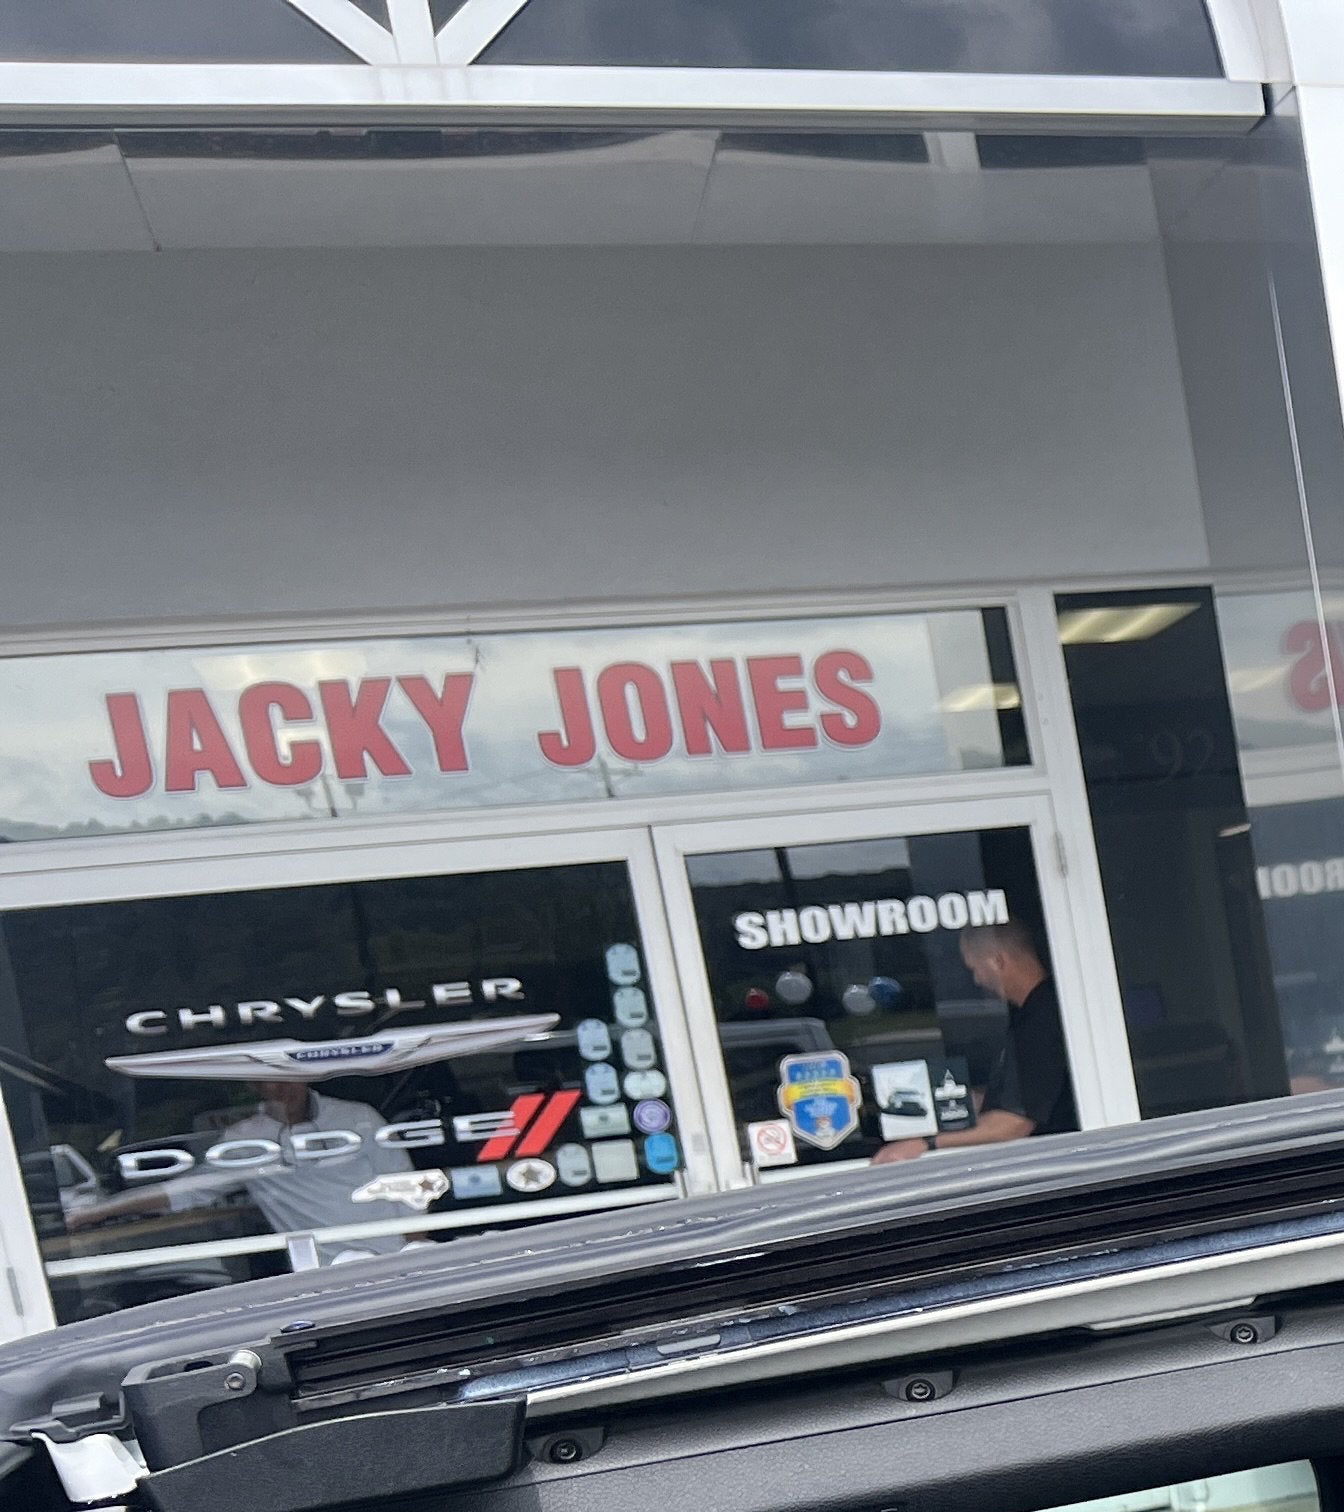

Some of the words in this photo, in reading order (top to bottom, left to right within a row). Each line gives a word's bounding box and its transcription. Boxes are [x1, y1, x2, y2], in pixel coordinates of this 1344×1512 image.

[88, 671, 476, 798] JACKY
[537, 648, 882, 767] JONES
[733, 889, 1011, 951] SHOWROOM
[125, 977, 526, 1036] CHRYSLER
[117, 1110, 521, 1180] DODGE
